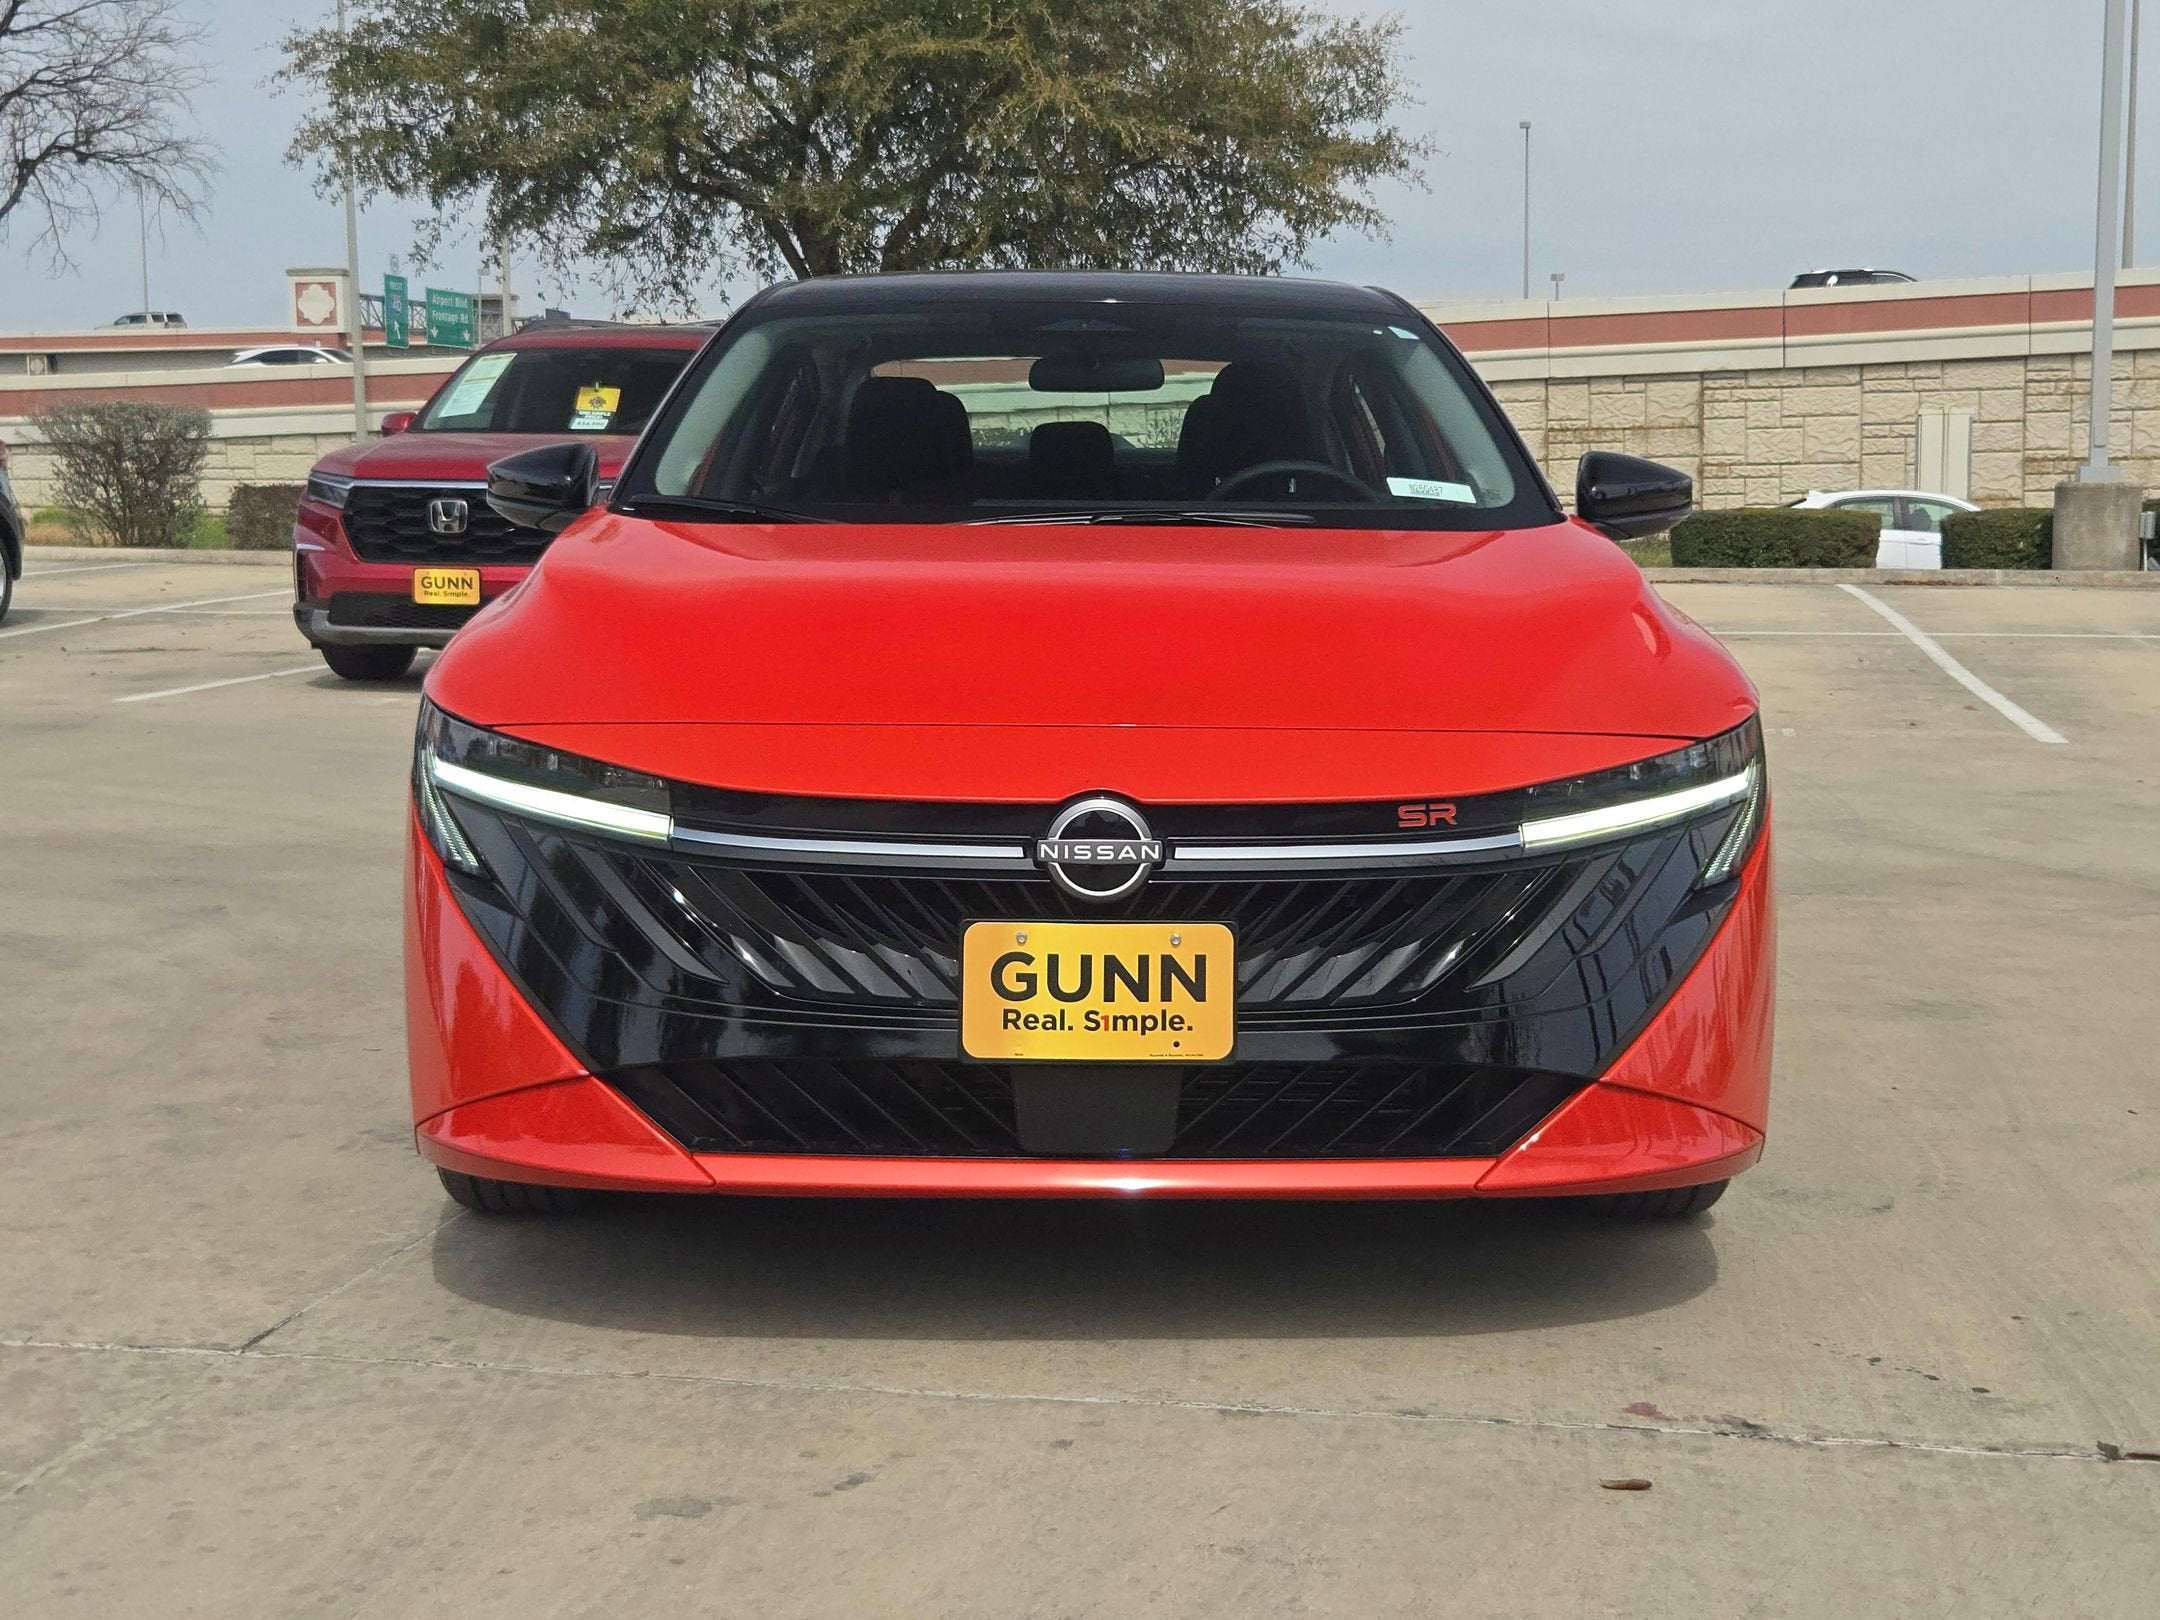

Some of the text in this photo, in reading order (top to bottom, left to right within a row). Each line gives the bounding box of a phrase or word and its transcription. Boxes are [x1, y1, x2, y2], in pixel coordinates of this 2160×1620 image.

[431, 293, 468, 309] Airport Blvd
[431, 310, 469, 324] Frontage Rd
[421, 576, 473, 590] GUNN
[424, 590, 442, 598] Real.
[1397, 803, 1458, 828] SR
[1040, 843, 1160, 861] NISSAN
[990, 951, 1207, 1003] GUNN
[1002, 1008, 1074, 1032] Real.
